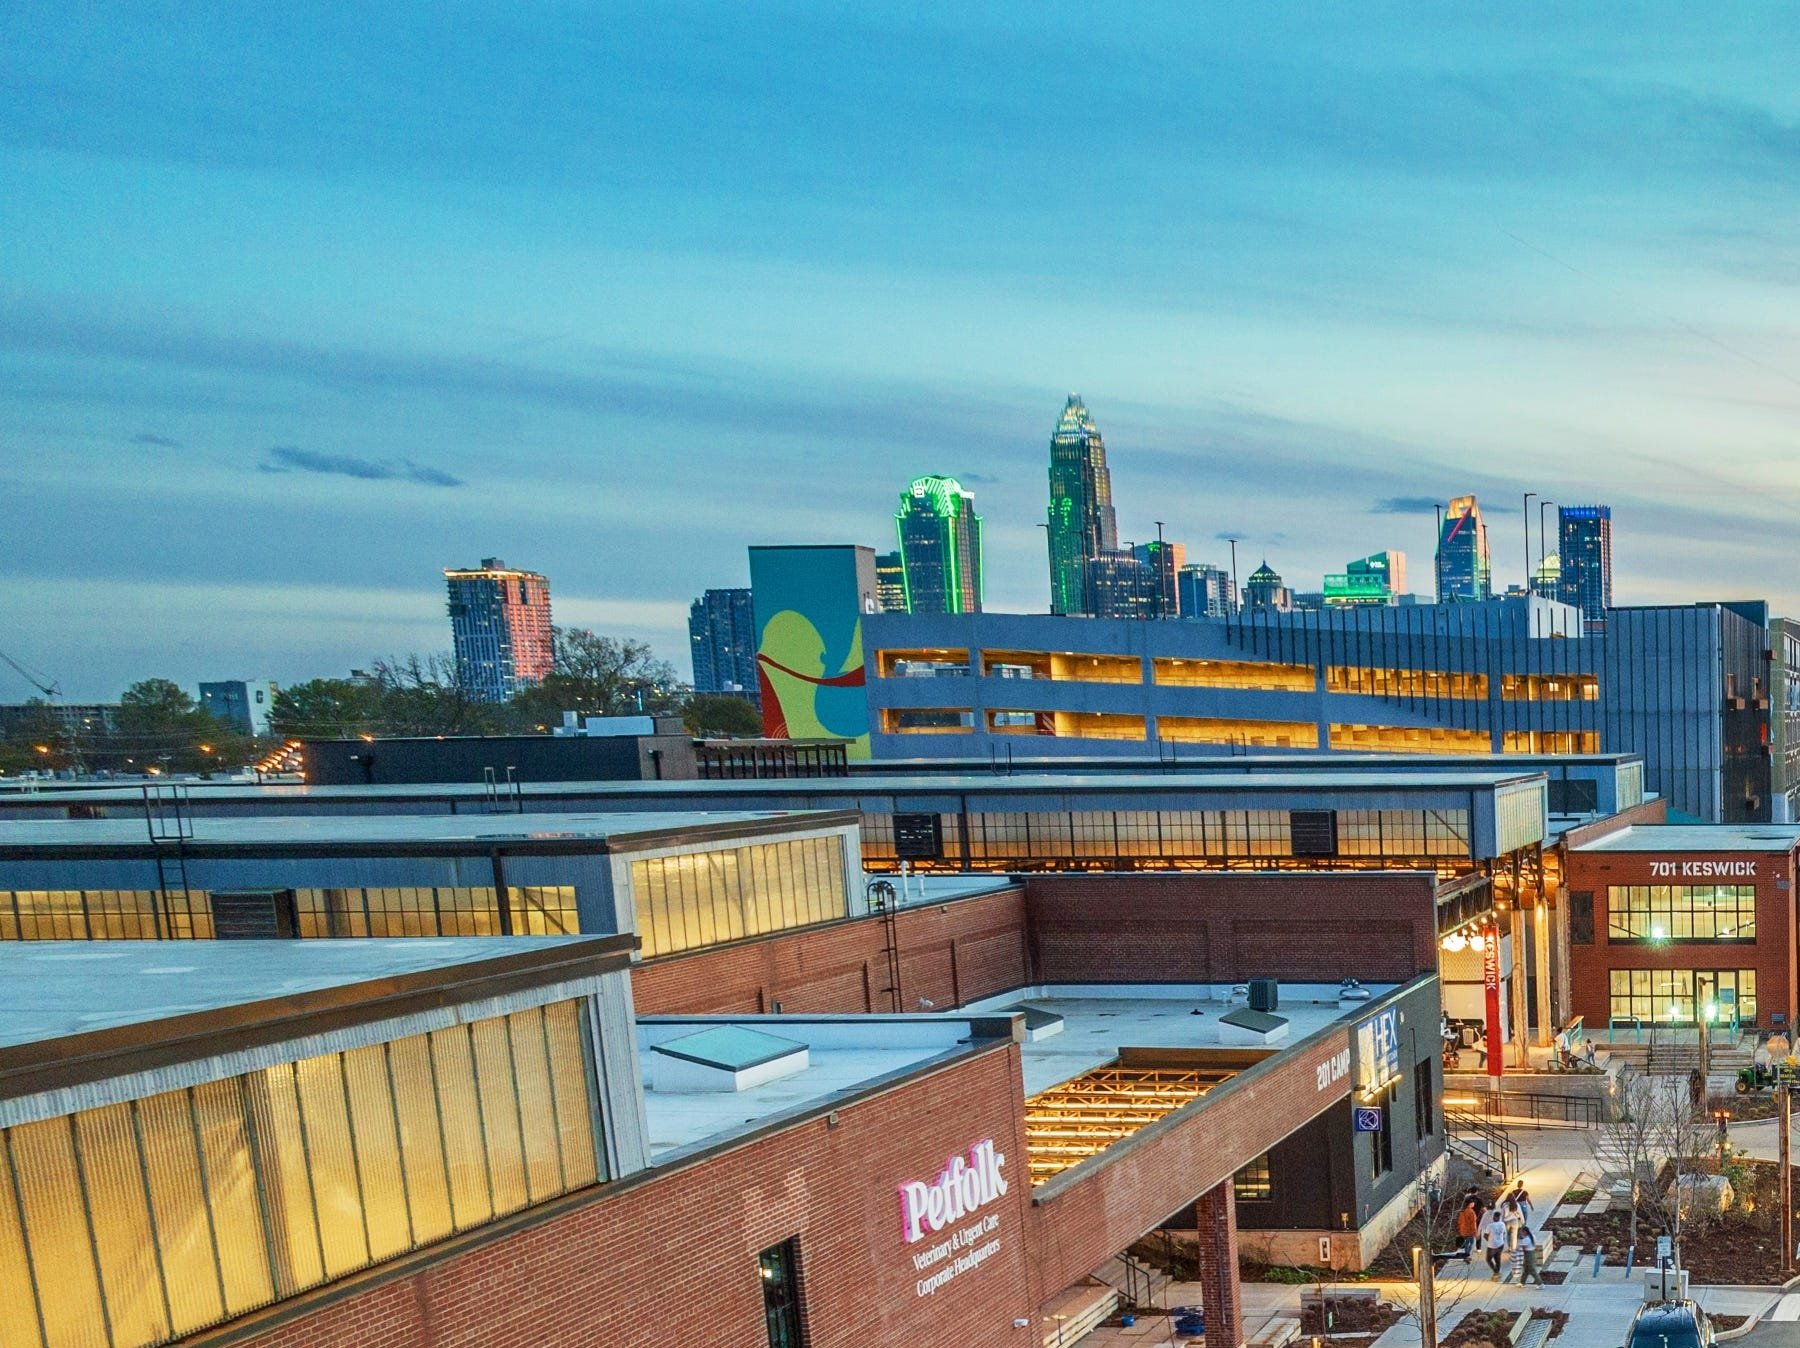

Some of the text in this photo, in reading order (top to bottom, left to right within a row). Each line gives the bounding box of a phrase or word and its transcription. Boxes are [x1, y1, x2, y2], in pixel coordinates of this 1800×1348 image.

[1650, 861, 1756, 877] 701 KESWICK
[1485, 935, 1497, 990] KESWICK
[1374, 1008, 1398, 1059] HEX
[1316, 1060, 1331, 1091] 201
[1331, 1047, 1351, 1082] CAMP
[902, 1138, 1008, 1243] Petfolk
[912, 1213, 999, 1271] Veterinary & Urgent Care
[916, 1237, 1001, 1297] Corporate Headquarters
